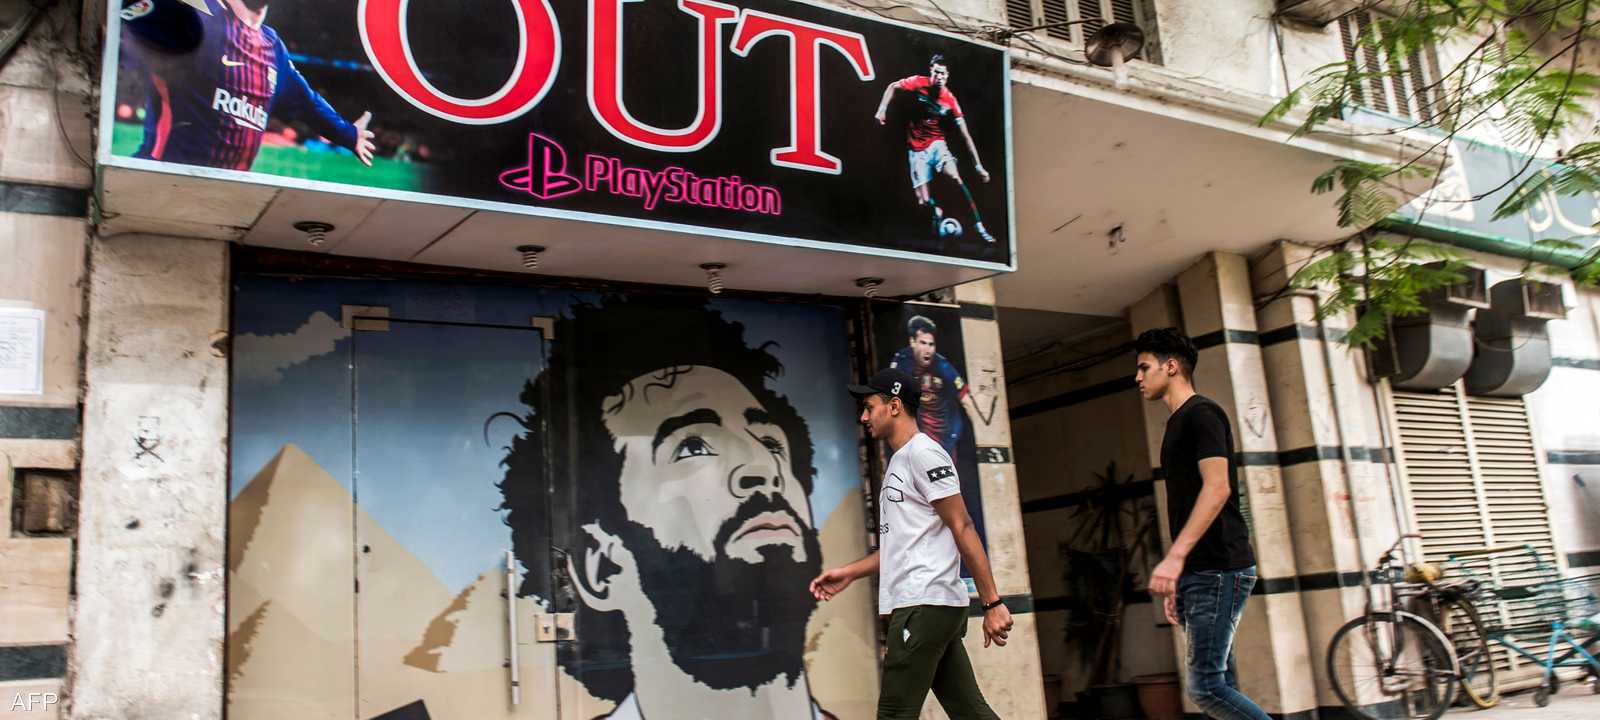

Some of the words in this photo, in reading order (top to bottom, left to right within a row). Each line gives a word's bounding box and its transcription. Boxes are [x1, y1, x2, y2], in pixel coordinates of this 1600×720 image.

[357, 0, 876, 174] OUT
[585, 153, 782, 216] PlayStation
[891, 381, 902, 395] 3
